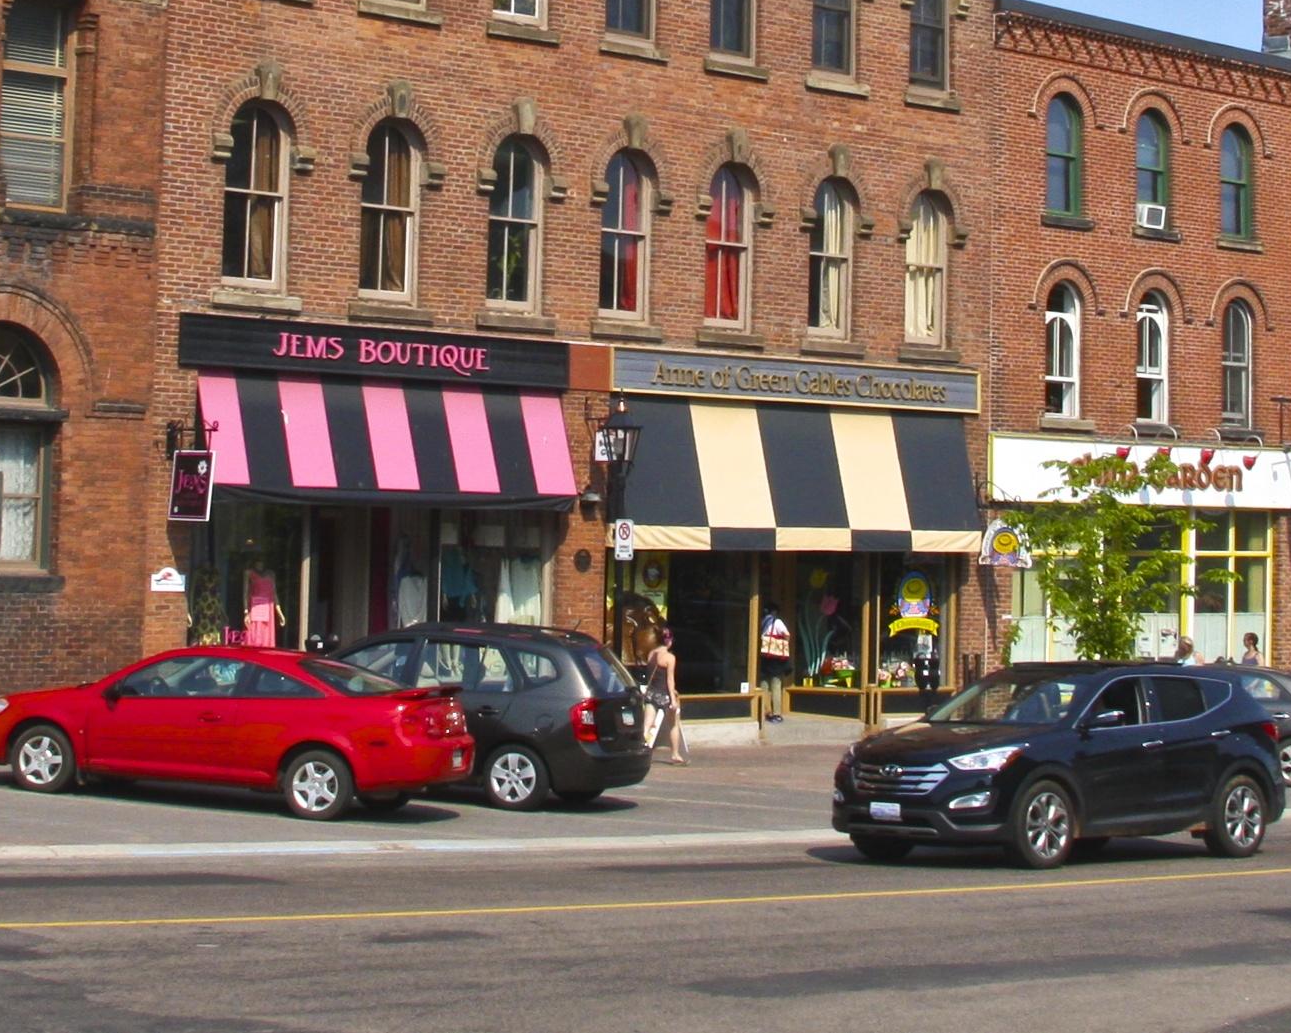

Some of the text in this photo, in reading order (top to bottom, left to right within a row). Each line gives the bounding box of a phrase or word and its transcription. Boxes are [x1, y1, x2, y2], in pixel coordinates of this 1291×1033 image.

[273, 332, 490, 376] JEMS BOUTIQUE
[652, 361, 948, 402] Anne of Green Gables Chocolates
